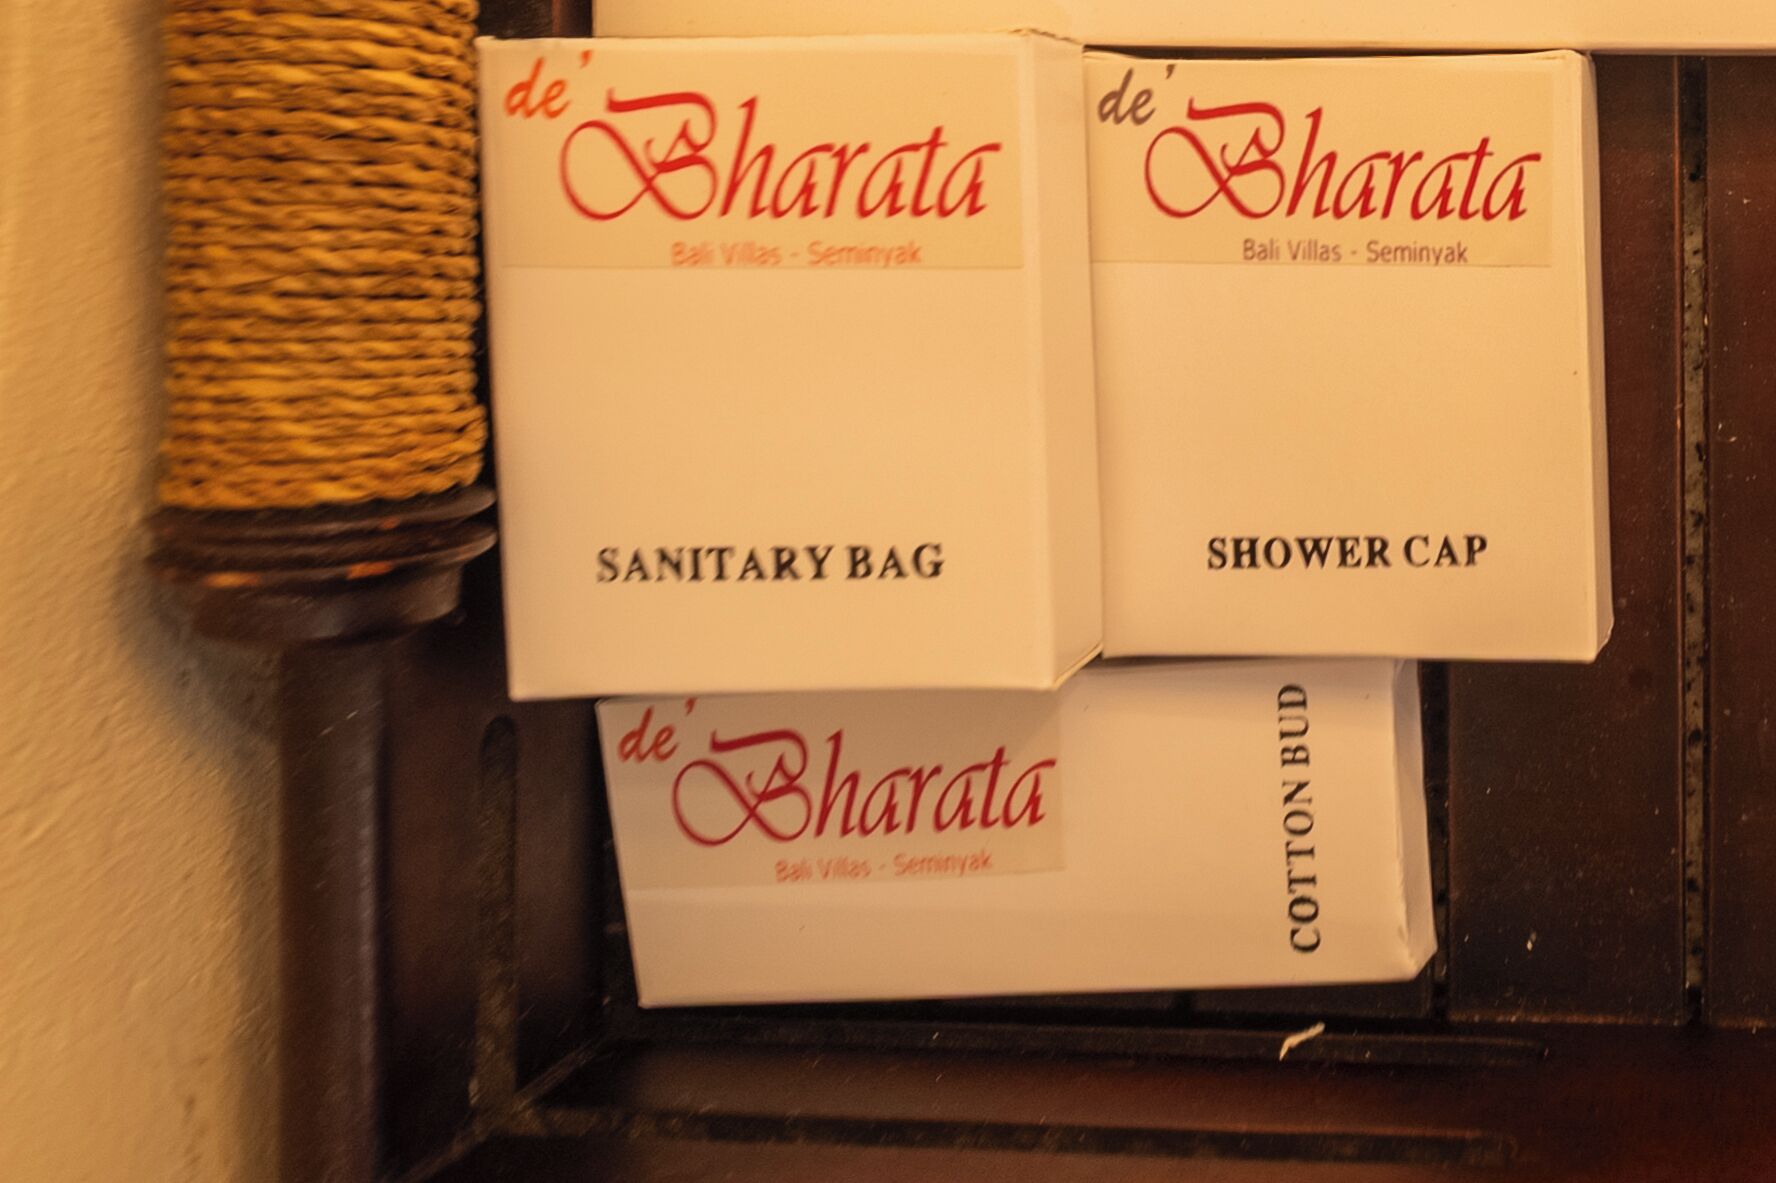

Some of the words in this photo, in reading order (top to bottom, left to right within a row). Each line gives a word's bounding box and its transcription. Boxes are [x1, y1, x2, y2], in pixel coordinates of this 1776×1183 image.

[560, 88, 1003, 221] Bharata
[1144, 97, 1542, 222] Bharata
[671, 241, 714, 266] Bali
[720, 242, 782, 266] Villas
[807, 241, 922, 269] Seminyak
[1243, 238, 1280, 261] Bali
[1287, 239, 1342, 262] Villas
[1366, 240, 1468, 266] Seminyak
[596, 545, 835, 583] SANITARY
[847, 542, 945, 579] BAG
[1206, 536, 1392, 570] SHOWER
[1404, 534, 1488, 568] CAP
[1277, 683, 1310, 768] BUD
[672, 728, 1057, 847] Bharata
[775, 859, 812, 883] Bali
[817, 857, 872, 880] Villas
[894, 849, 992, 877] Seminyak
[1281, 779, 1321, 954] COTTON
